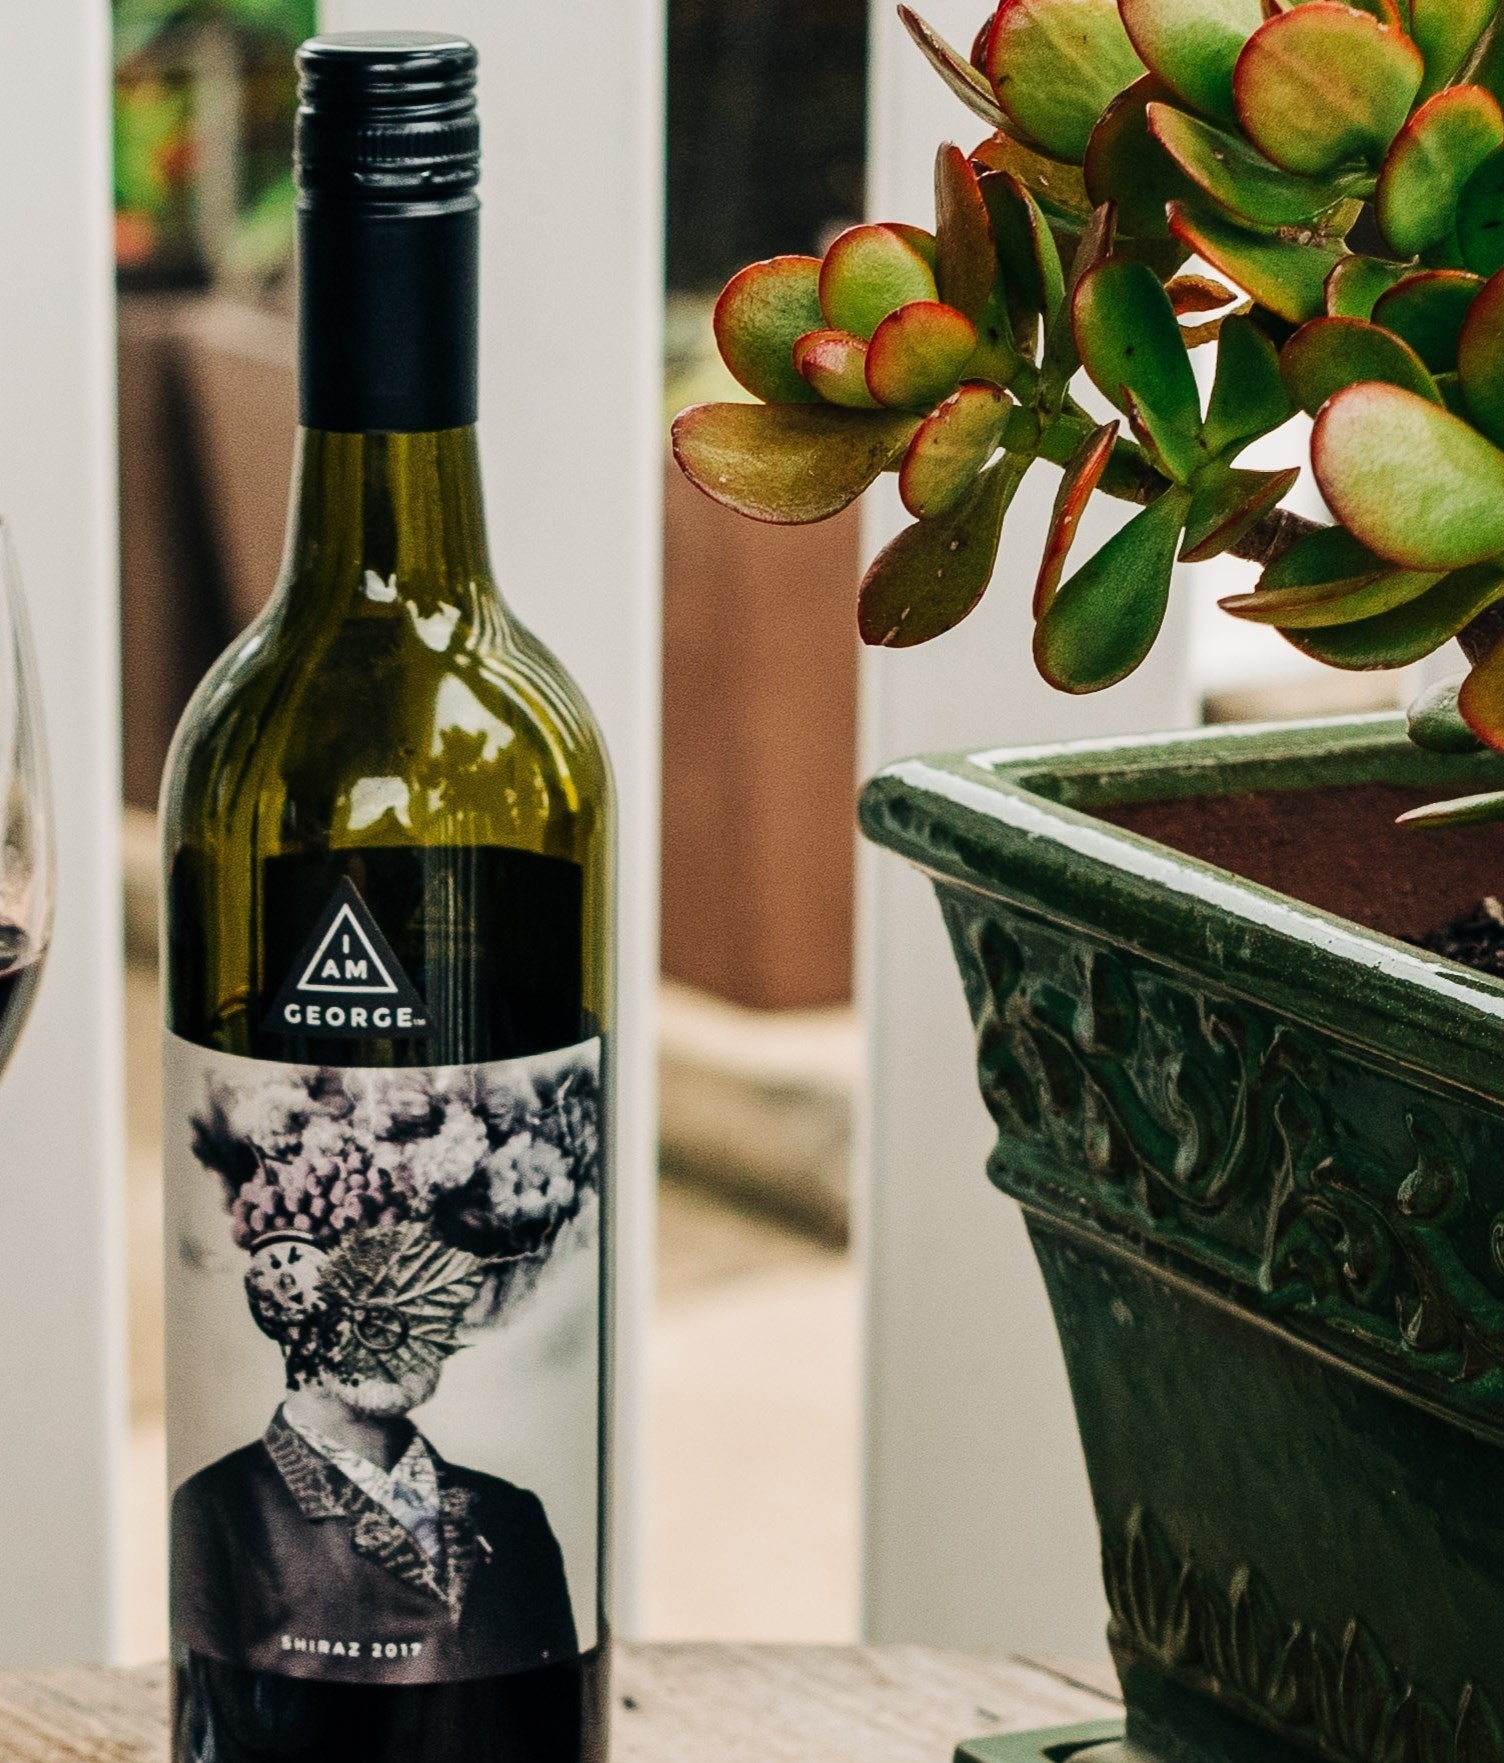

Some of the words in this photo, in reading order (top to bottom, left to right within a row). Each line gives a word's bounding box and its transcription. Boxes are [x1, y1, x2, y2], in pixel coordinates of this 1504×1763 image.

[342, 934, 350, 954] I
[321, 959, 368, 980] AM
[283, 1003, 414, 1029] GEORGE
[280, 1634, 361, 1658] SHIRAZ
[371, 1642, 422, 1659] 2017
